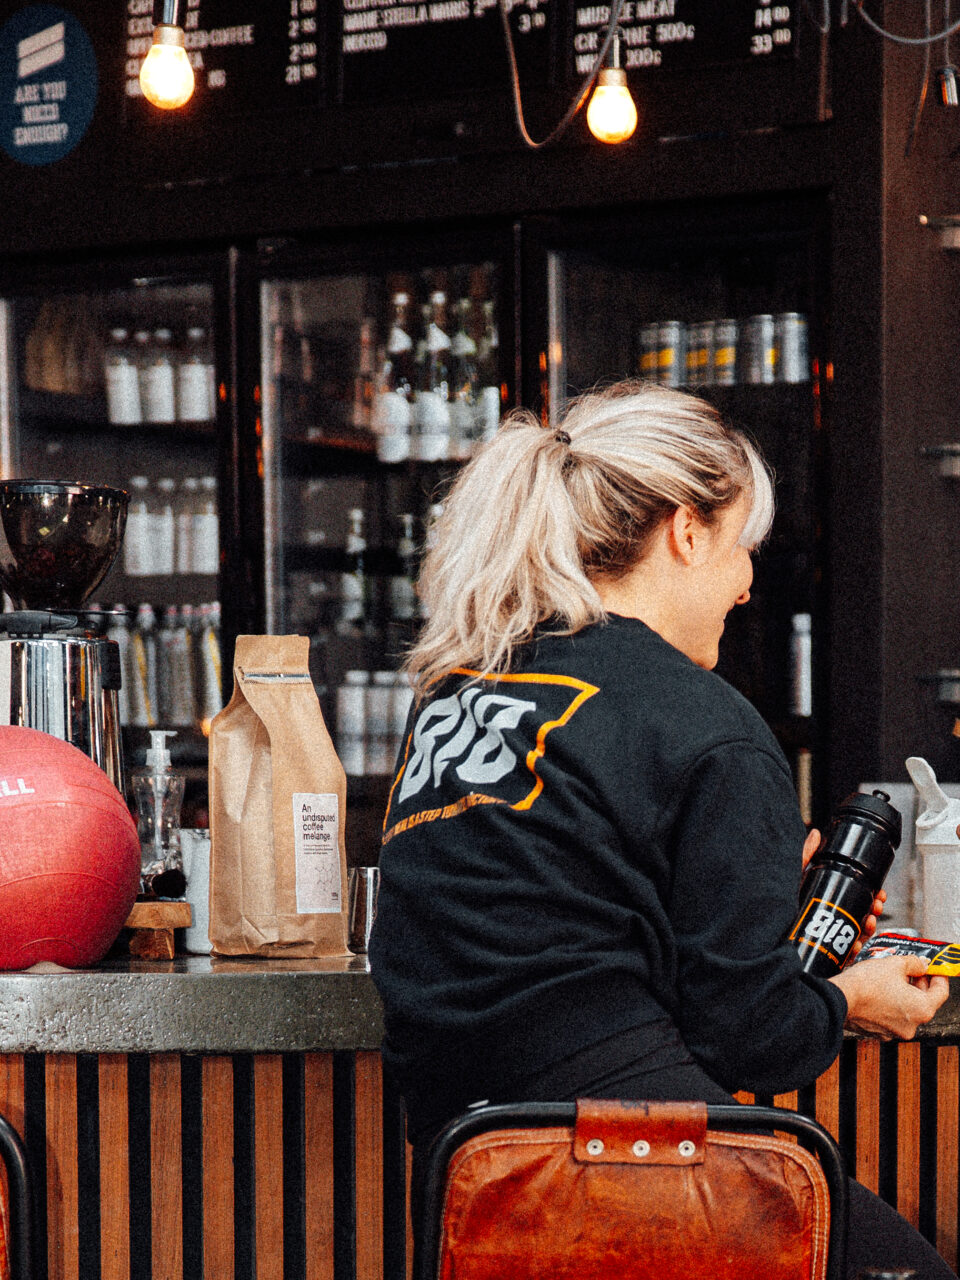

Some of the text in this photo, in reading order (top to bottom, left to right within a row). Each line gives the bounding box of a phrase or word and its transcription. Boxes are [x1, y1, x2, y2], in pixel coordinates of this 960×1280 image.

[576, 3, 635, 27] MUSLE
[42, 80, 67, 101] YOU
[0, 777, 36, 799] LL
[301, 803, 312, 813] An
[302, 813, 336, 823] undisputed
[302, 822, 324, 832] coffee
[804, 908, 856, 956] 818
